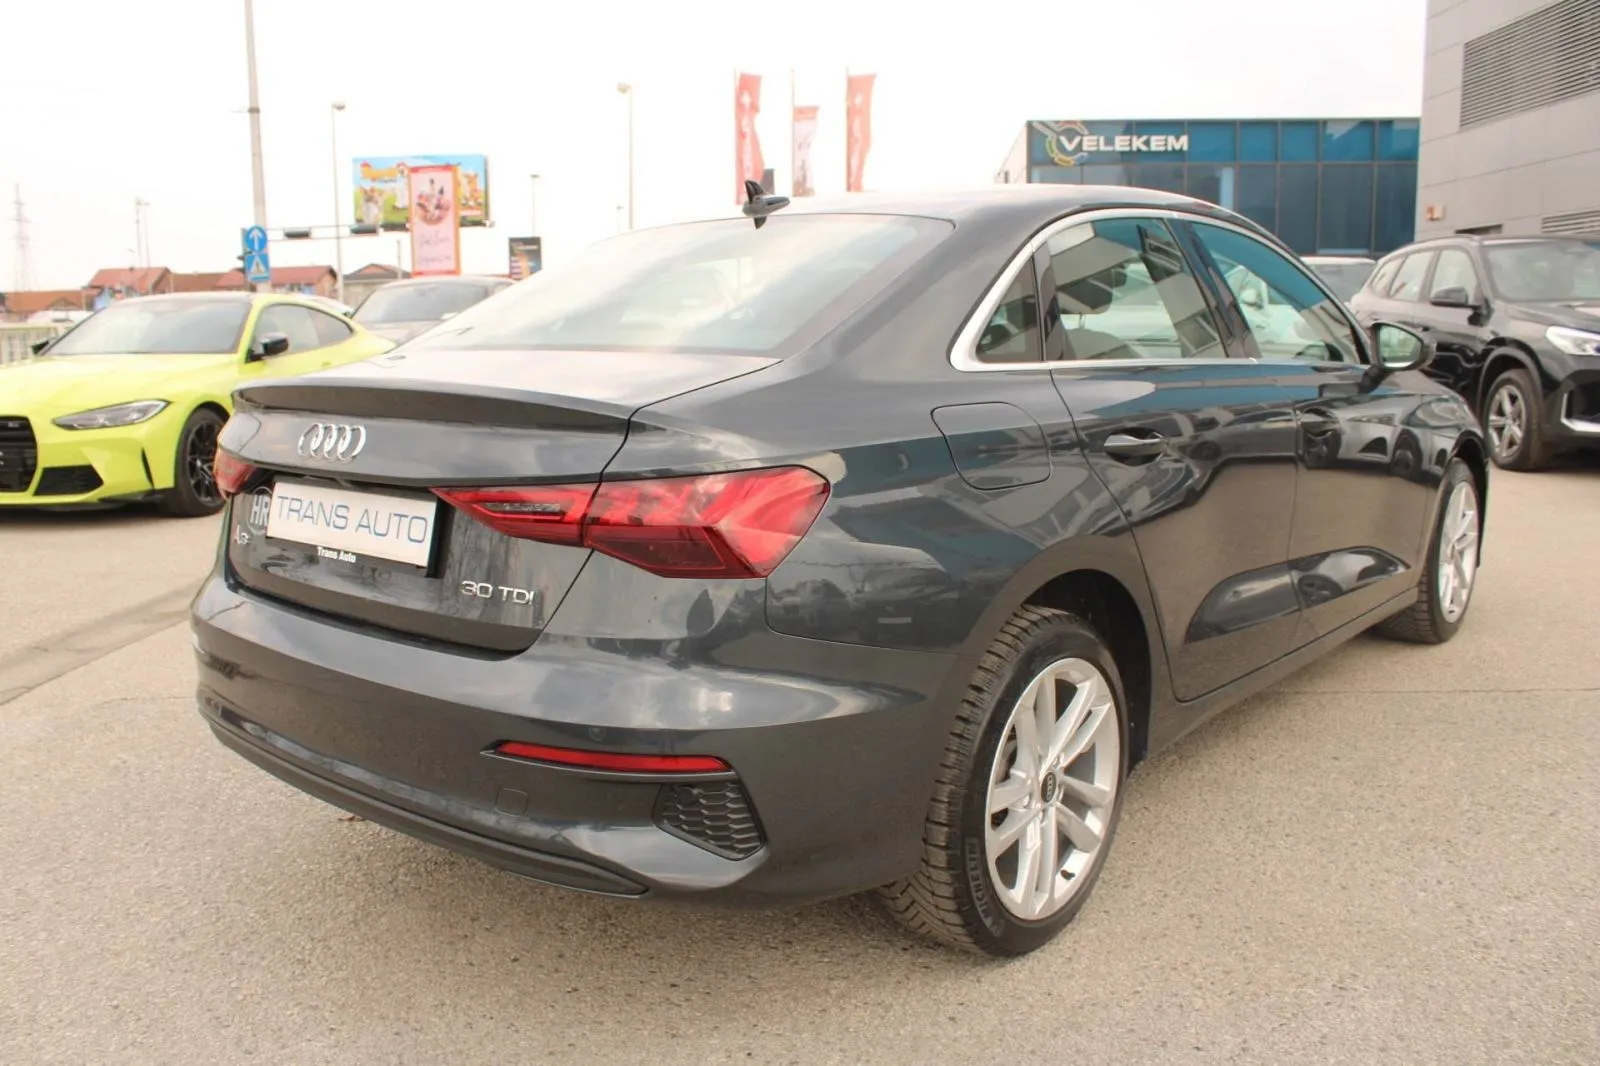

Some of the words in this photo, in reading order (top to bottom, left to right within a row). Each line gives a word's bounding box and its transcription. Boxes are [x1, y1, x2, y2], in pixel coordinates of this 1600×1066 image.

[1059, 134, 1189, 152] VELEKEM
[250, 494, 271, 526] HR
[277, 495, 350, 530] TRANS
[355, 508, 428, 543] AUTO
[317, 546, 338, 560] Trans
[338, 550, 357, 563] Auto
[461, 580, 493, 598] 30
[498, 586, 535, 605] TDI
[967, 842, 989, 919] MICHELIN
